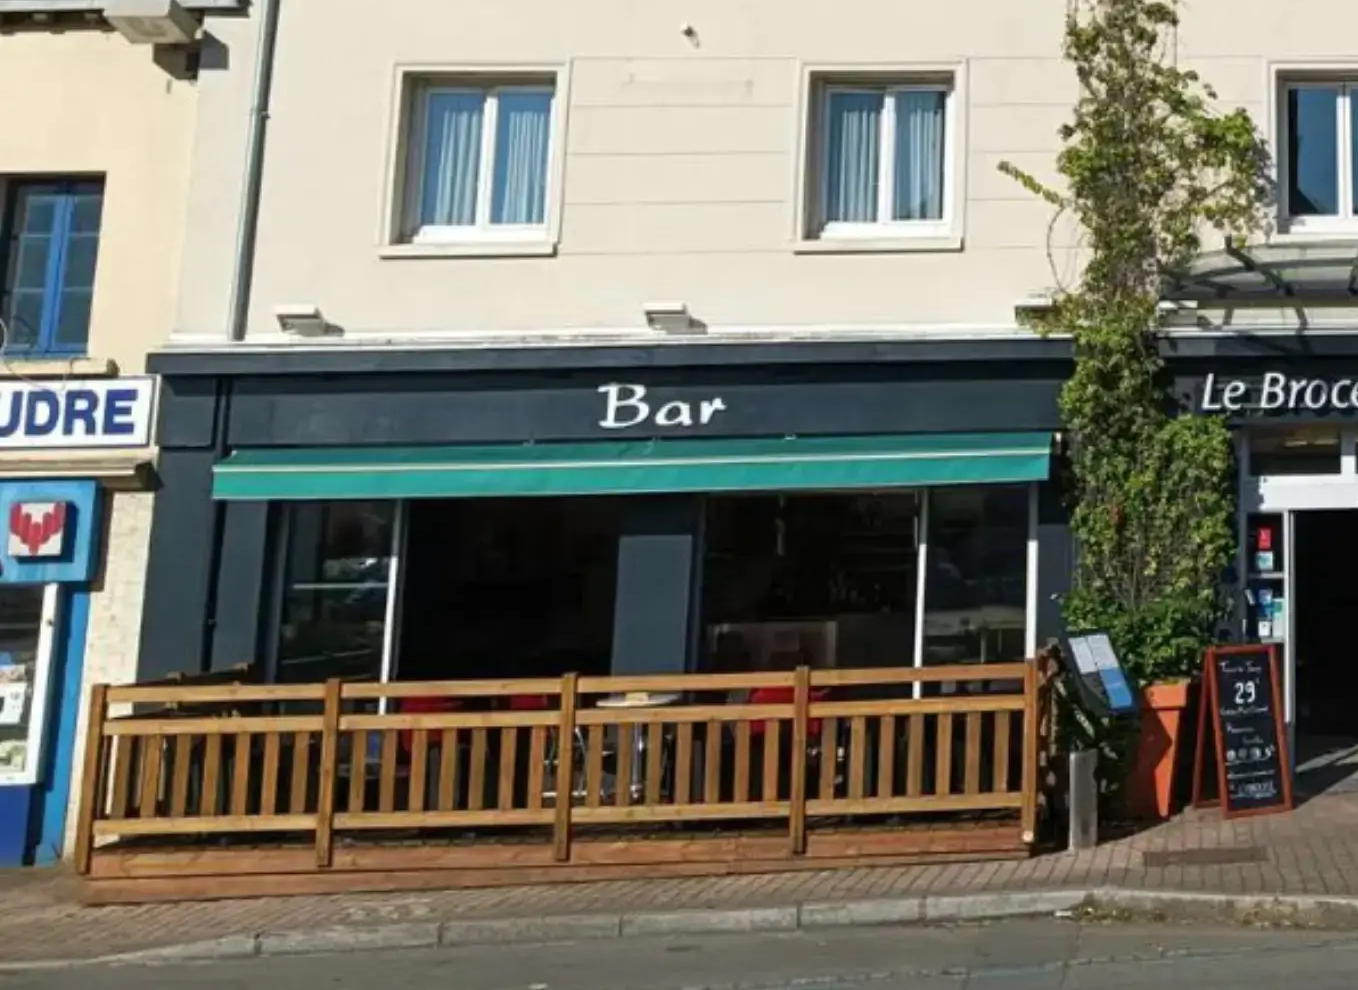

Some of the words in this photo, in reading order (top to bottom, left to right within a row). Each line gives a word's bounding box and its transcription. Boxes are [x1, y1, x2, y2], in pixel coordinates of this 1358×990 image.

[597, 382, 727, 428] Bar
[1201, 371, 1246, 410] Le
[1234, 680, 1256, 704] 29
